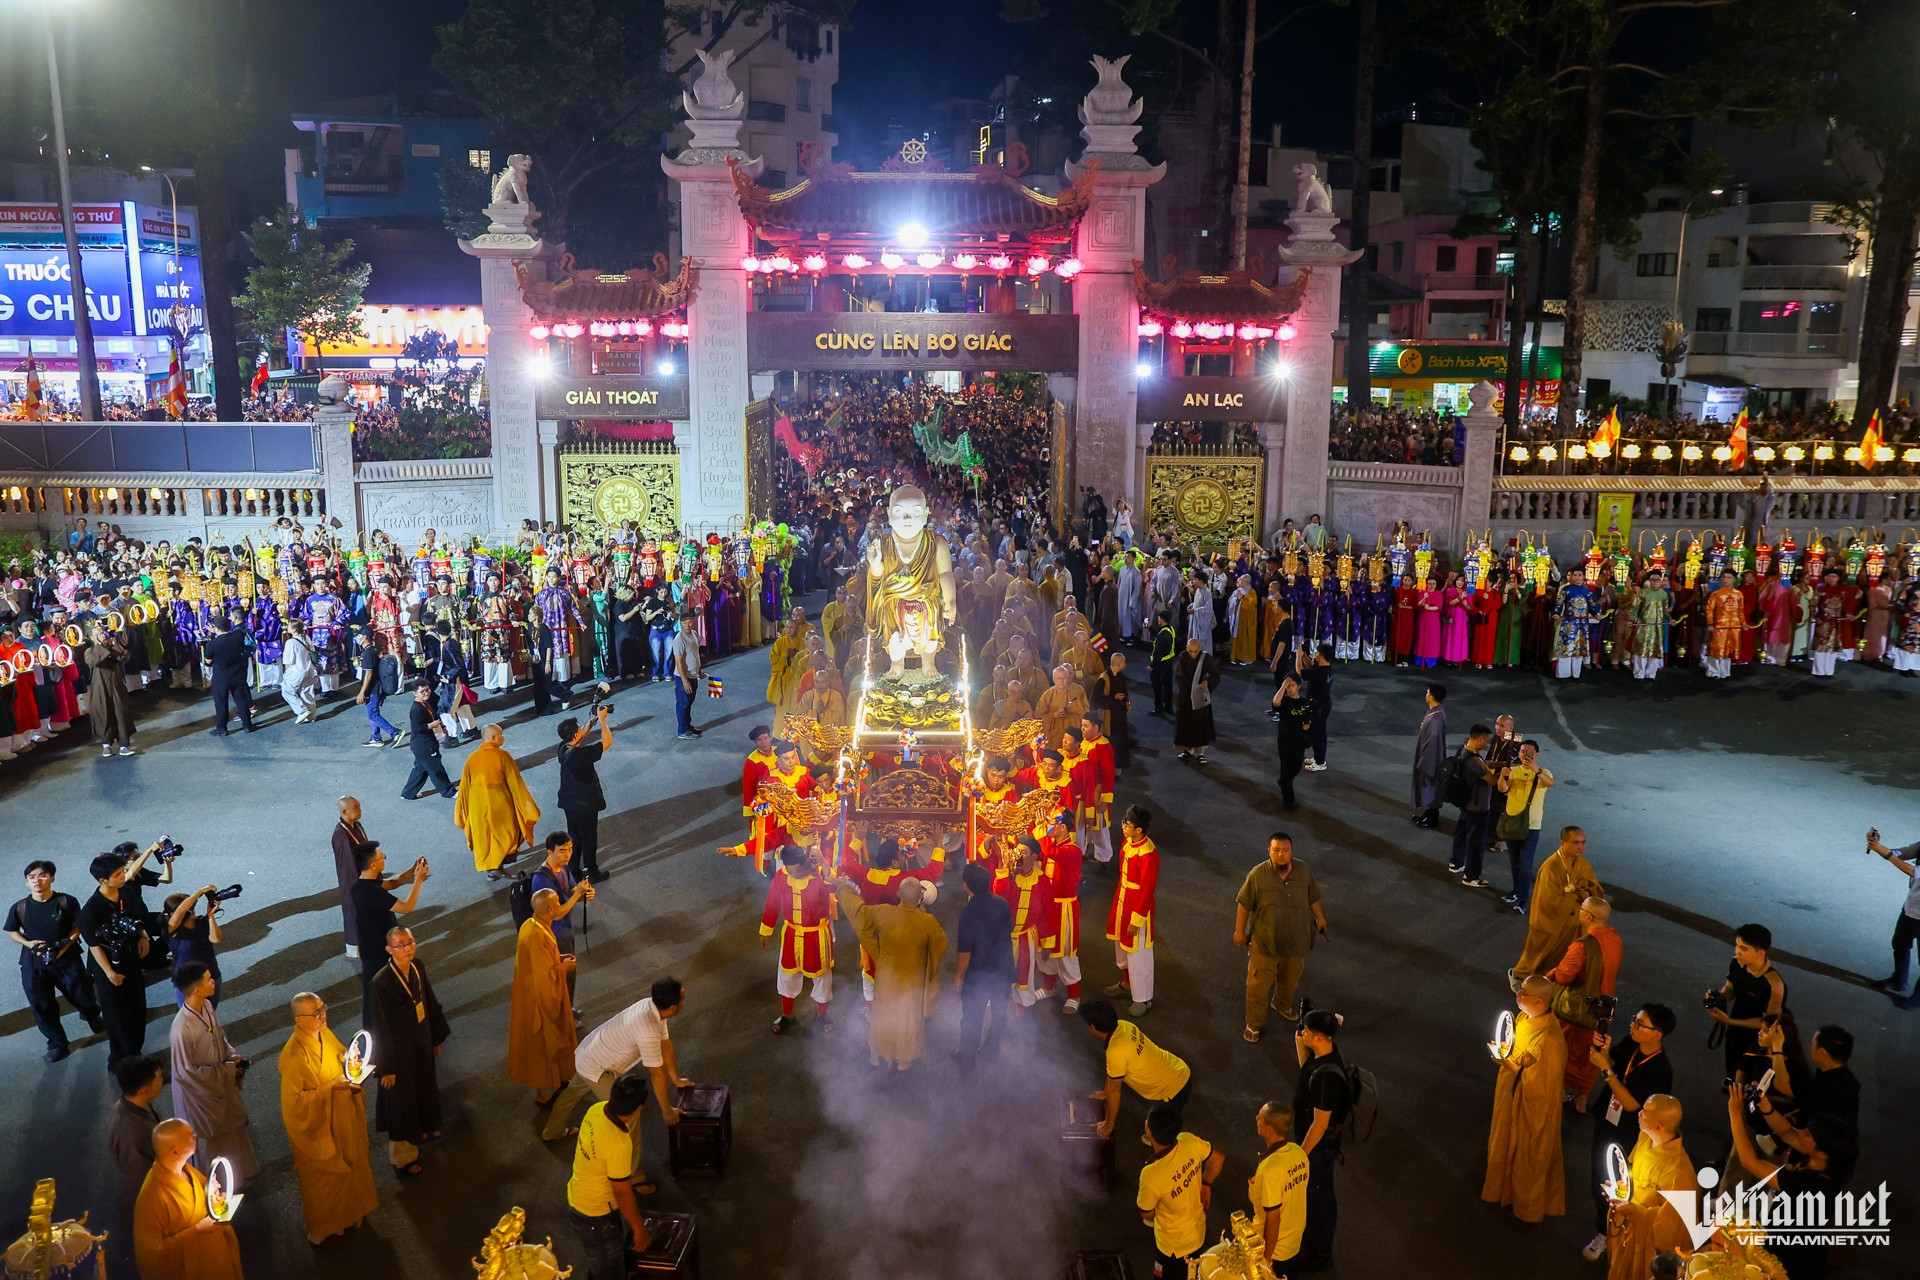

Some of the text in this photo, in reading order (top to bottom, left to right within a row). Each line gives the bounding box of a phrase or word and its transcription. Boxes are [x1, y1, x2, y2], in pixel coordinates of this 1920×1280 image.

[21, 209, 56, 221] NGỪA
[88, 210, 114, 222] THƯ
[170, 280, 191, 299] THỐC
[27, 286, 122, 322] CHÂU
[815, 328, 1012, 351] CÙNG LÊN BỜ GIÁC
[1427, 355, 1508, 368] Bách hóa XAN
[565, 386, 659, 405] GIẢI THOÁT
[1182, 393, 1244, 410] AN LẠC
[704, 452, 738, 468] Trần
[704, 485, 742, 500] Mộng
[380, 510, 482, 529] TRANG NGHIÊM
